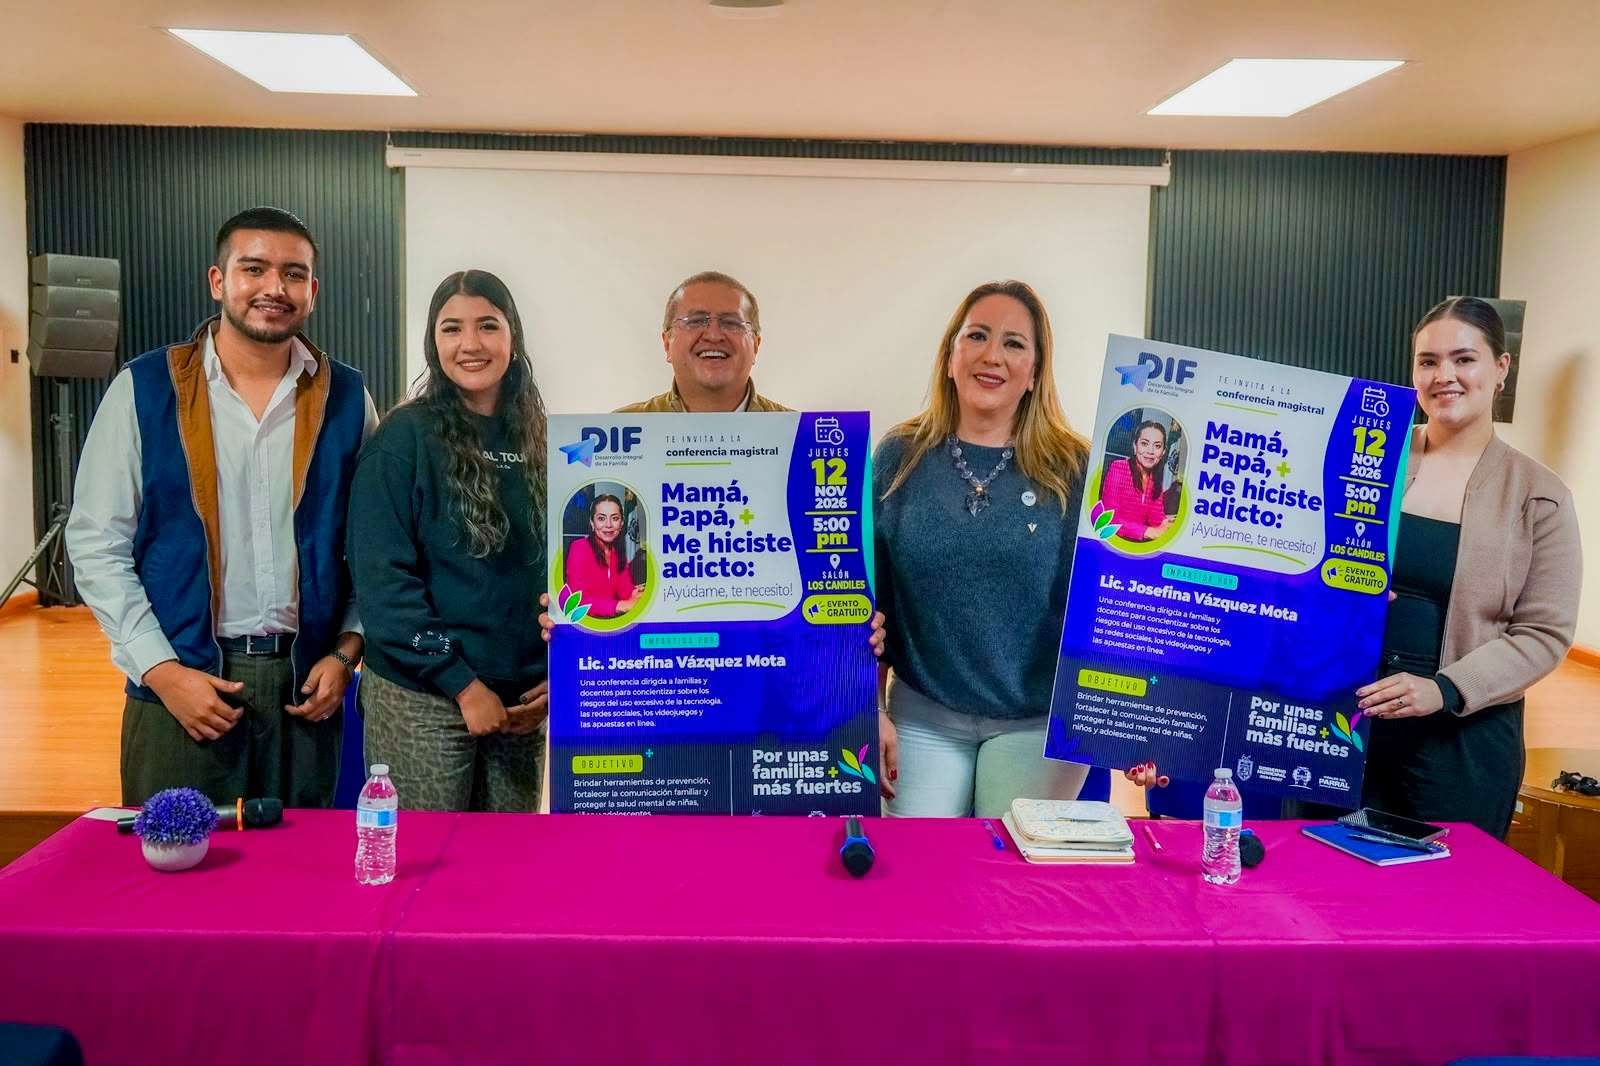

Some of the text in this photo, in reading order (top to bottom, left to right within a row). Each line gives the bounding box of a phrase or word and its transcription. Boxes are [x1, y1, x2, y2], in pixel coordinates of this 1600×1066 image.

[1139, 351, 1198, 384] DIF
[1219, 376, 1228, 384] TE
[1234, 379, 1264, 390] INVITA
[1217, 390, 1324, 415] conferencia magistral
[1352, 415, 1391, 430] JUEVES
[582, 427, 642, 452] DIF
[1206, 420, 1288, 457] Mamá,
[1352, 426, 1386, 457] 12
[500, 452, 528, 463] TOU
[666, 447, 778, 457] conferencia magistral
[808, 448, 848, 457] JUEVES
[1352, 453, 1383, 467] NOV
[1202, 444, 1271, 478] Papá,
[812, 458, 847, 485] 12
[1350, 465, 1381, 480] 2026
[662, 480, 748, 505] Mamá,
[815, 486, 846, 497] NOV
[1198, 471, 1323, 511] Me hiciste
[1345, 484, 1380, 502] 5:00
[816, 498, 847, 508] 2026
[1194, 495, 1282, 528] adicto:
[1346, 499, 1376, 515] pm
[662, 503, 734, 531] Papá,
[814, 518, 850, 532] 5:00
[662, 532, 792, 553] Me hiciste
[817, 533, 848, 548] pm
[1192, 522, 1316, 554] ¡Ayúdame, te necesito!
[1346, 537, 1371, 548] SALÓN
[1330, 544, 1385, 562] LOS CANDILES
[663, 556, 754, 577] adicto:
[822, 569, 849, 579] SALÓN
[1346, 566, 1376, 578] EVENTO
[808, 581, 865, 590] LOS CANDILES
[1344, 574, 1384, 588] GRATUITO
[664, 584, 793, 601] ¡Ayúdame, te necesito!
[1100, 575, 1297, 621] Lic. Josefina Vázquez Mota
[827, 608, 868, 617] GRATUITO
[1097, 606, 1129, 617] docentes
[1147, 617, 1189, 628] concientizar
[1099, 596, 1215, 622] Una conferencia familias
[1096, 617, 1120, 626] riesgos
[1147, 627, 1176, 636] excesivo
[1104, 640, 1135, 650] apuestas
[1125, 634, 1153, 643] sociales,
[1165, 640, 1206, 652] videojuegos
[579, 654, 786, 670] Lic. Josefina Vázquez Mota
[1088, 674, 1137, 690] OBJETIVO
[1077, 692, 1207, 721] Brindar herramientas prevención,
[1251, 696, 1323, 721] Por unas
[1076, 702, 1198, 730] fortalecer comunicación familiar
[1249, 710, 1316, 736] familias
[1072, 723, 1148, 742] niños adolescentes.
[1074, 714, 1193, 740] proteger salud mental niñas,
[1246, 729, 1348, 757] más fuertes
[582, 760, 634, 768] OBJETIVO
[753, 750, 829, 762] Por unas
[752, 764, 824, 779] familias
[667, 777, 710, 786] prevención,
[753, 778, 861, 795] más fuertes
[1318, 778, 1350, 790] PARRAL
[574, 801, 606, 809] proteger
